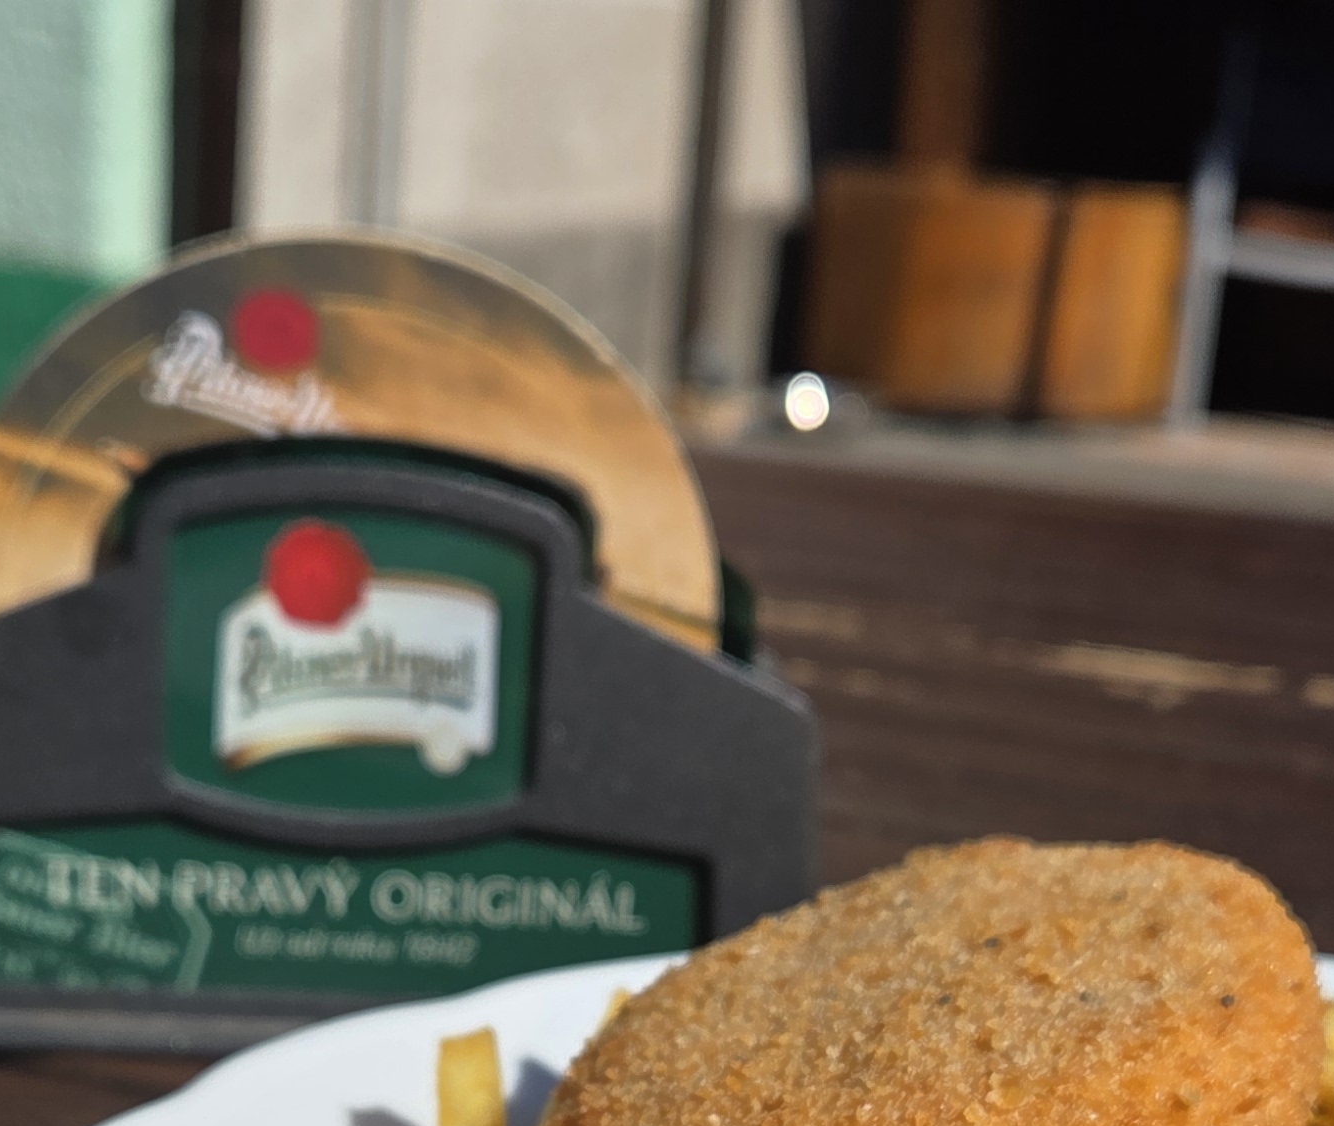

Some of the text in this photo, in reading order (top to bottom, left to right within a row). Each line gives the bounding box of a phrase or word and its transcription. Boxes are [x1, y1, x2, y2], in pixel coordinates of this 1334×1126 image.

[44, 854, 162, 911] TEN
[172, 857, 359, 921] PRAVÝ
[369, 868, 650, 936] ORIGINÁL
